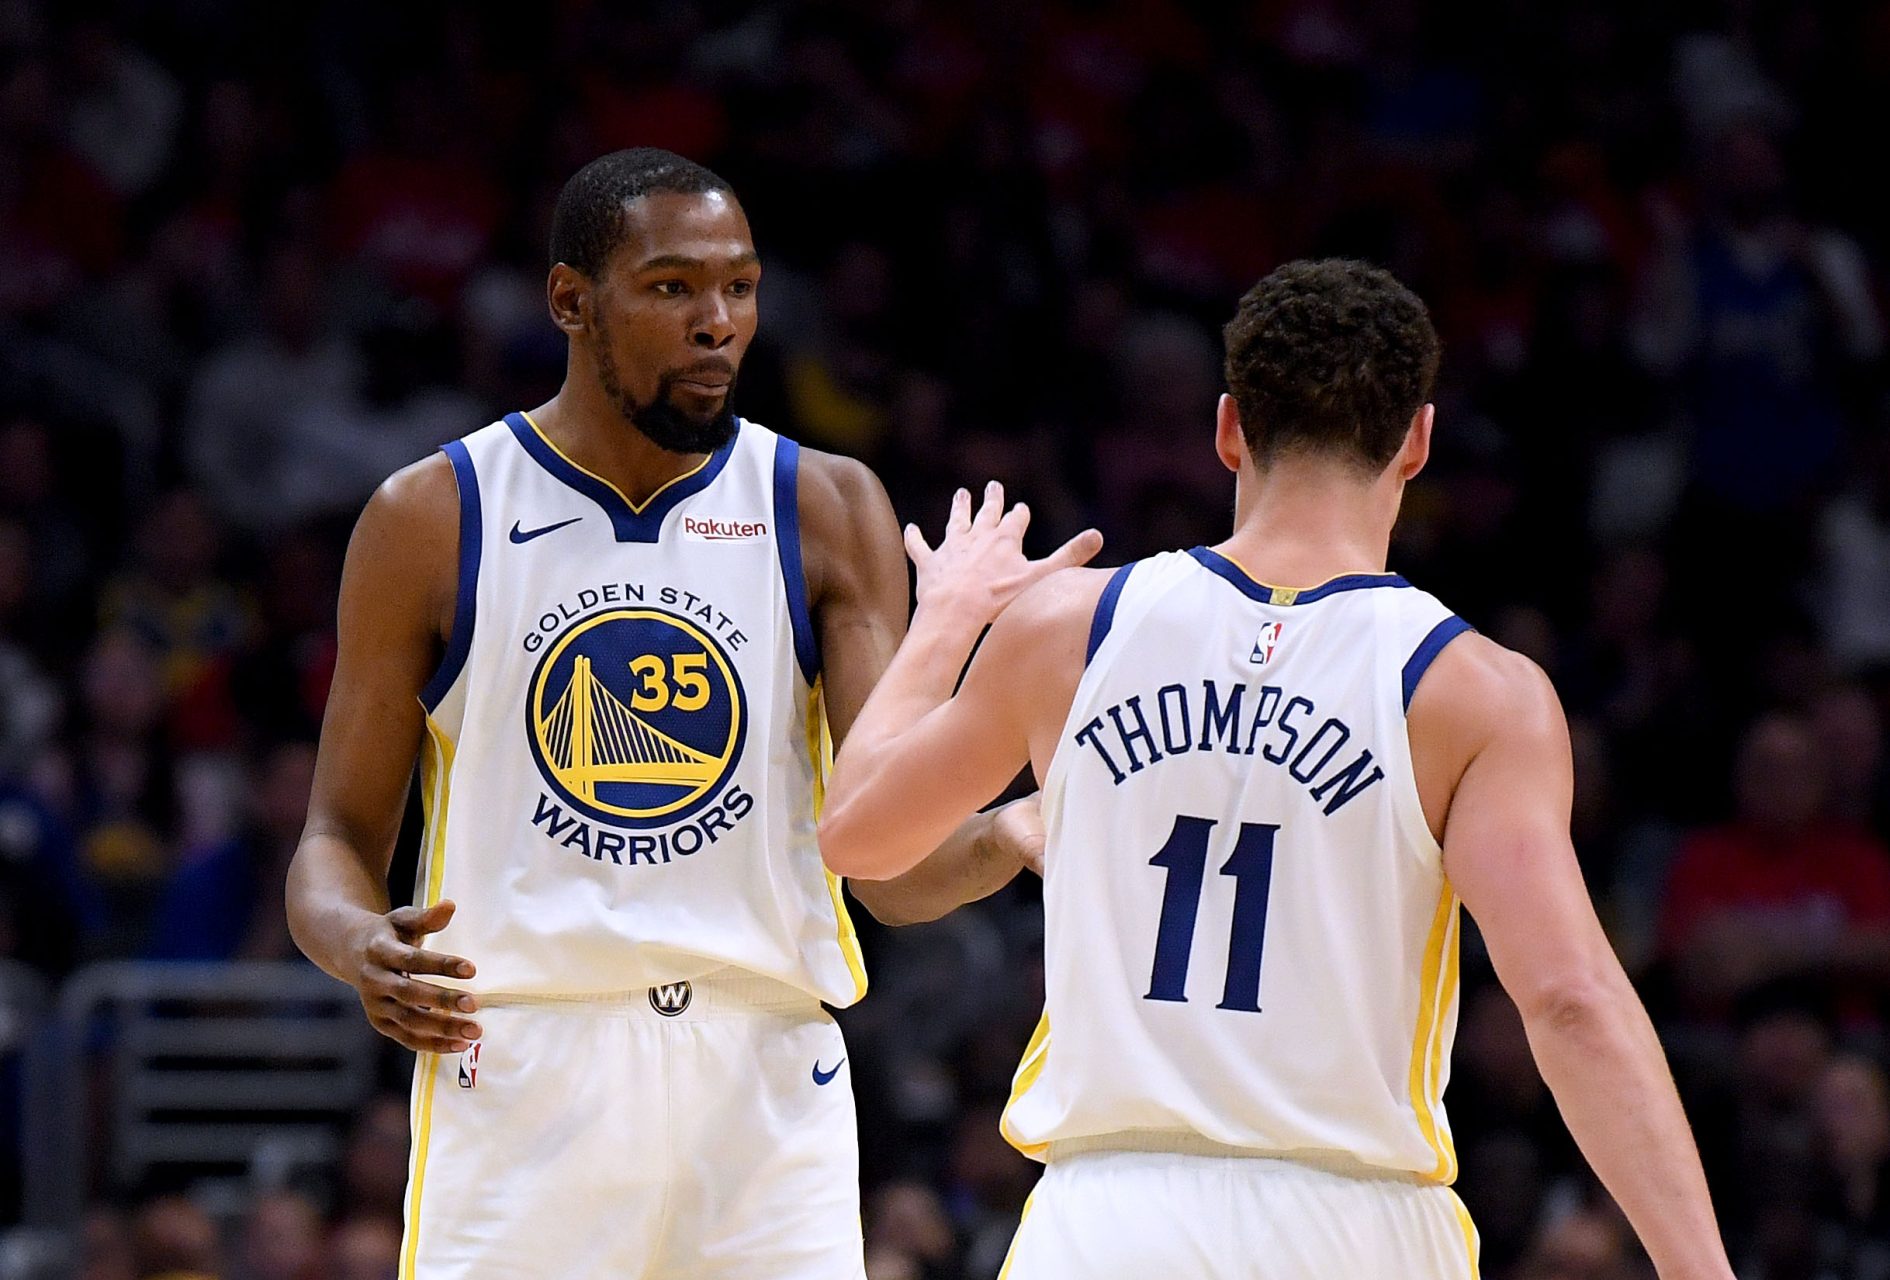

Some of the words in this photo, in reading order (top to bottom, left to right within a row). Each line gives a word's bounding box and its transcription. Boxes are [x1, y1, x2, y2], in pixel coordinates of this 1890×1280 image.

[685, 517, 767, 537] Rakuten
[523, 583, 644, 653] GOLDEN
[659, 586, 749, 652] STATE
[628, 651, 712, 712] 35
[1074, 679, 1385, 817] THOMPSON
[530, 784, 754, 866] WARRIORS
[1142, 814, 1282, 1013] 11
[656, 983, 688, 1008] W
